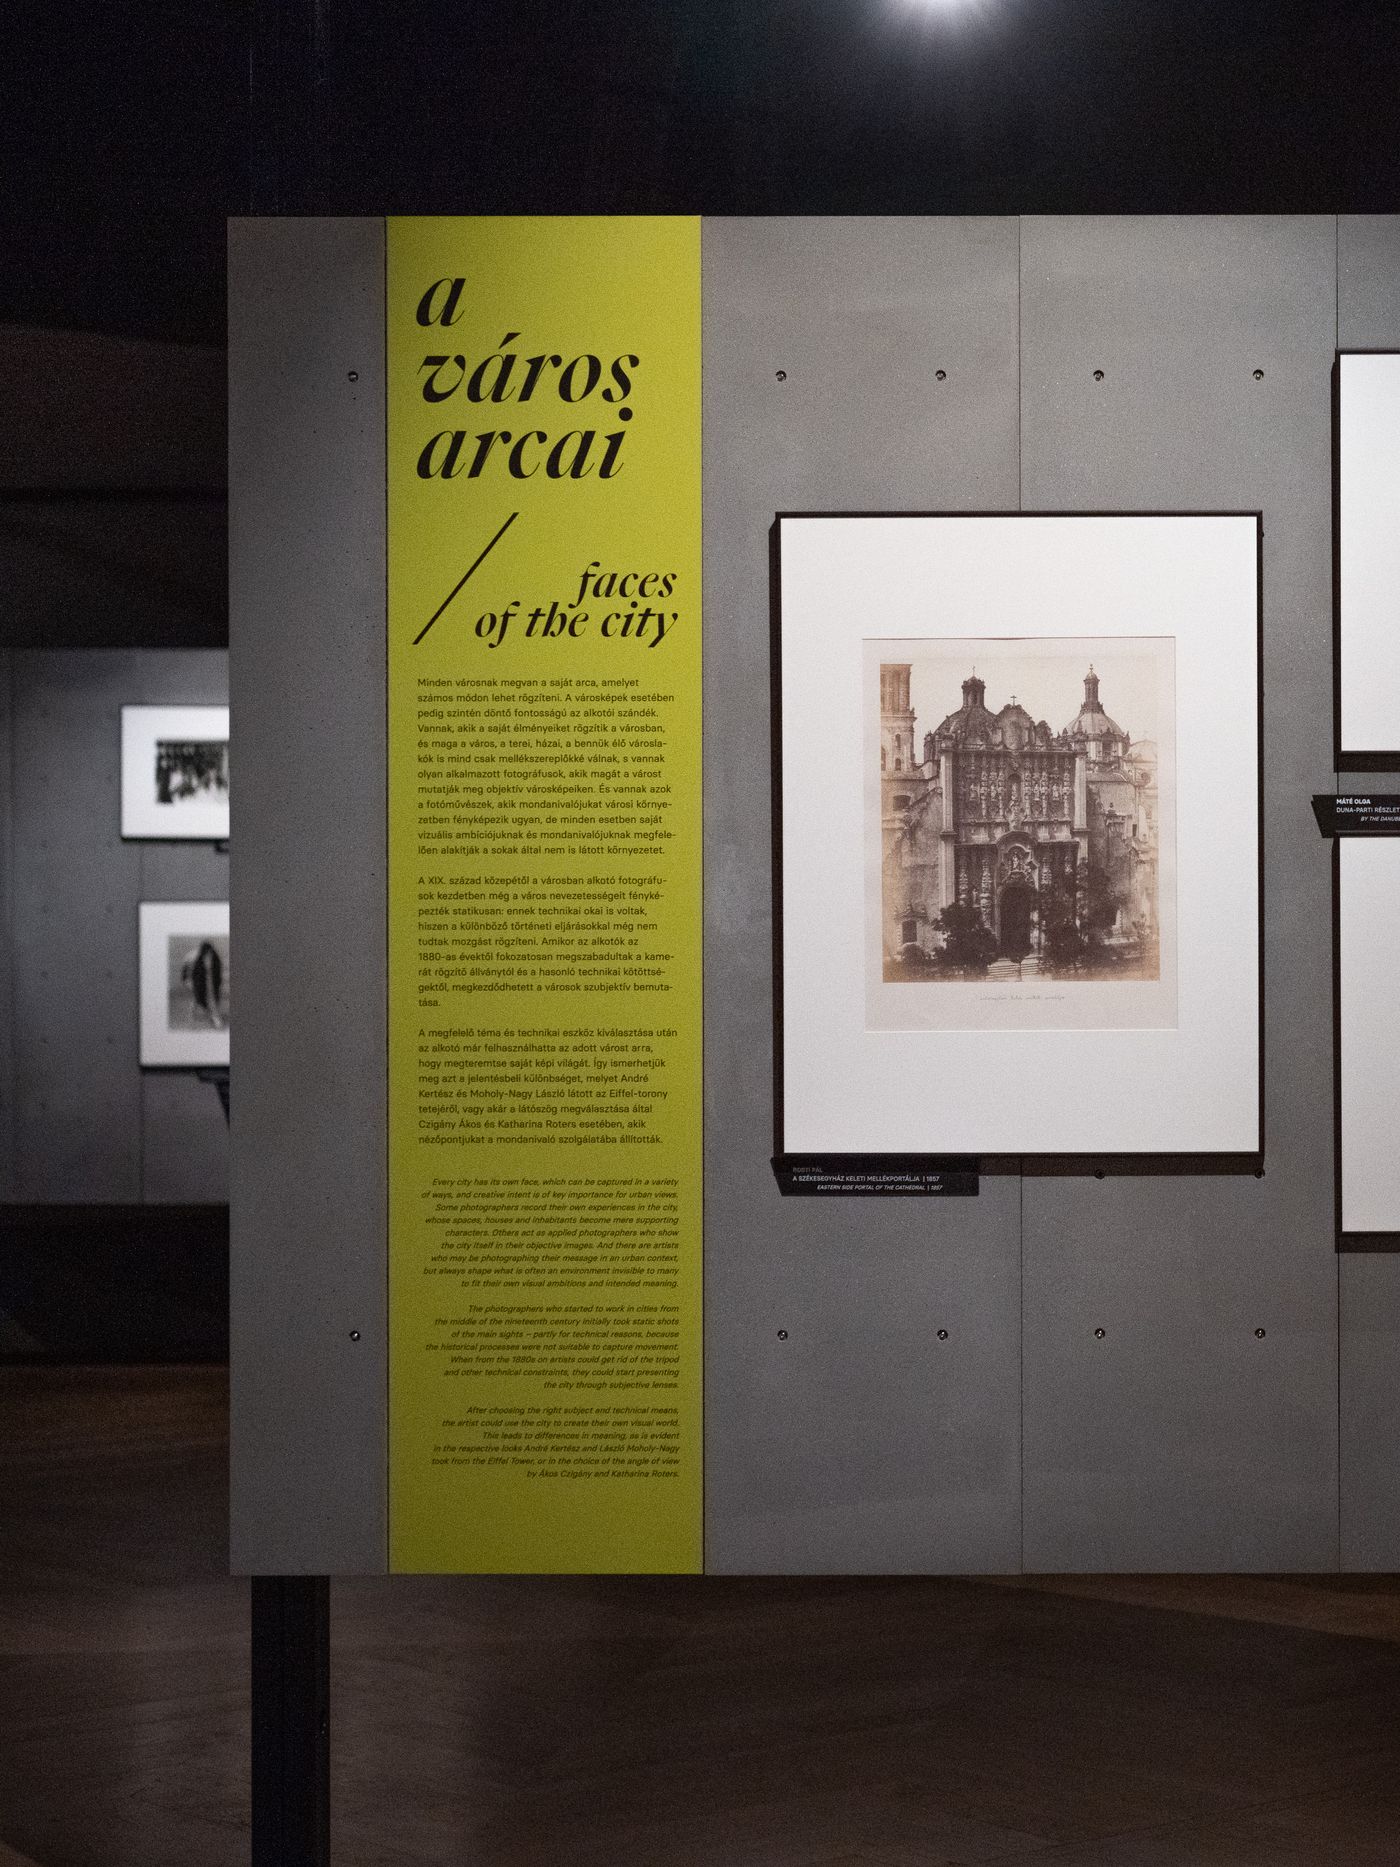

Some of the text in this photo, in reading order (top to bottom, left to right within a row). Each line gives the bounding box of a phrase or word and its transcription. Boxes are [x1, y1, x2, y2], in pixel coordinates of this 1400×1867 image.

[416, 277, 466, 327] a
[417, 332, 640, 403] város
[416, 407, 634, 480] arcai
[568, 562, 678, 608] faces
[475, 601, 679, 648] of the city
[417, 677, 452, 687] Minden
[455, 677, 498, 687] városnak
[500, 679, 538, 690] megvan
[550, 677, 573, 690] saját
[575, 679, 598, 689] arca,
[601, 677, 639, 690] amelyet
[417, 692, 454, 703] számos
[456, 692, 489, 703] módon
[492, 692, 516, 703] lehet
[630, 692, 675, 703] esetében
[417, 707, 444, 720] pedig
[447, 707, 481, 718] szintén
[583, 707, 615, 718] alkotói
[617, 707, 659, 718] szándék.
[418, 722, 454, 735] Vannak,
[457, 722, 476, 733] akik
[488, 722, 511, 736] saját
[573, 722, 608, 736] rögzítik
[417, 768, 443, 781] olyan
[569, 768, 588, 779] akik
[590, 768, 621, 781] magát
[632, 768, 662, 779] várost
[418, 783, 460, 796] mutatják
[462, 785, 484, 796] meg
[486, 783, 523, 796] objektív
[613, 783, 647, 794] vannak
[650, 783, 672, 794] azok
[428, 875, 446, 885] XIX.
[449, 875, 482, 885] század
[541, 875, 584, 885] városban
[587, 875, 616, 885] alkotó
[418, 951, 457, 961] 1880-as
[644, 951, 675, 961] kame-
[477, 1027, 501, 1038] téma
[562, 1027, 594, 1038] eszköz
[656, 1027, 678, 1038] után
[418, 1088, 453, 1098] Kertész
[535, 1088, 565, 1098] László
[567, 1088, 593, 1098] látott
